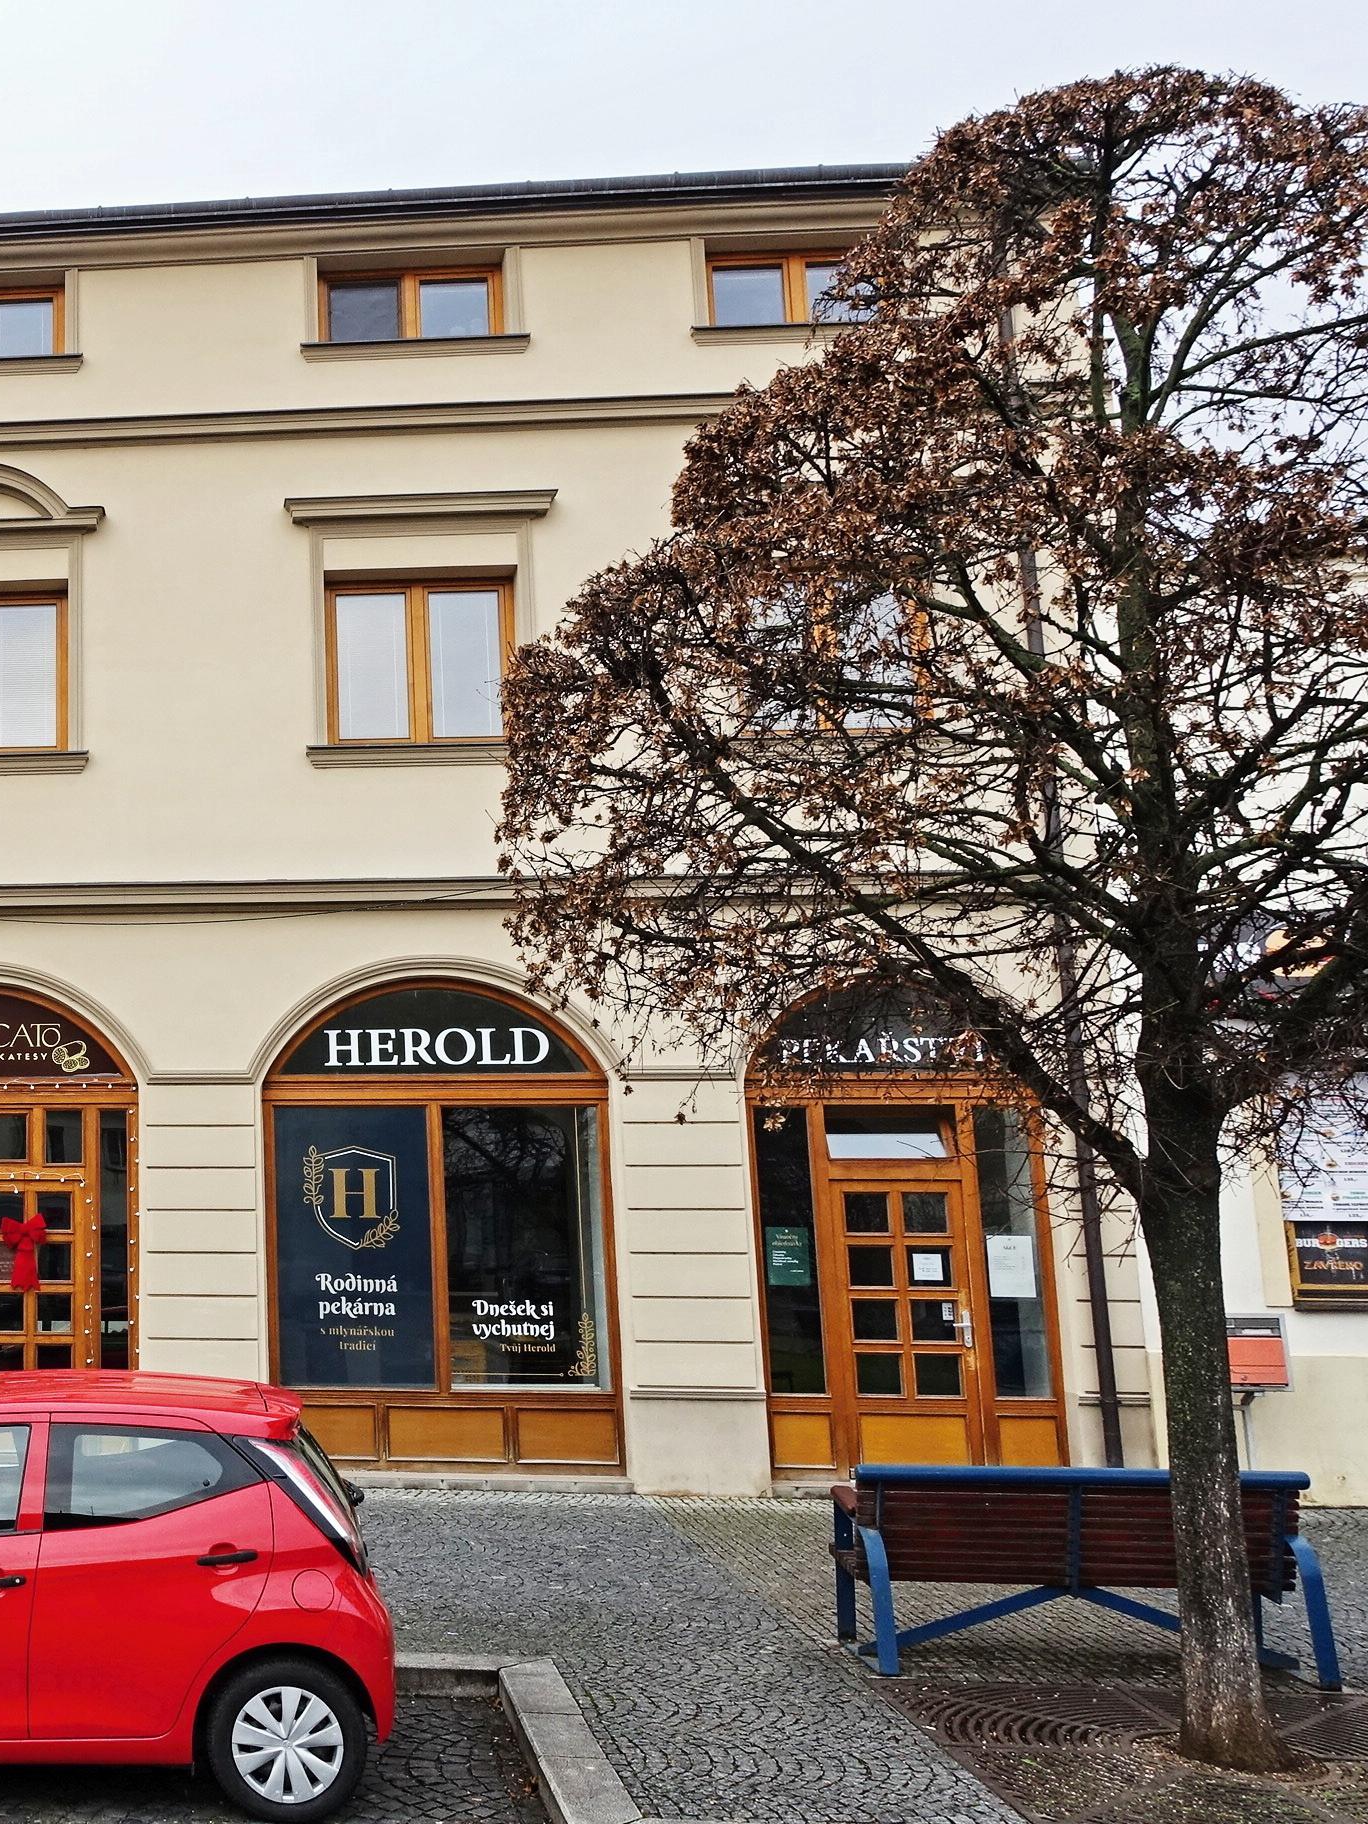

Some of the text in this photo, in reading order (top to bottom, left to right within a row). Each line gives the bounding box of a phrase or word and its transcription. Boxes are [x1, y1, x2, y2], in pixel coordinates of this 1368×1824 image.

[323, 1027, 550, 1066] HEROLD
[778, 1030, 985, 1063] PEKAŘST
[328, 1168, 381, 1219] H
[315, 1273, 398, 1294] Rodinná
[318, 1296, 396, 1319] pekárna
[472, 1299, 553, 1319] Dnešek si
[329, 1325, 395, 1337] mlynářskou
[472, 1319, 555, 1340] vychutnej
[339, 1340, 376, 1351] tradicí
[500, 1343, 556, 1353] Tvůj Herold
